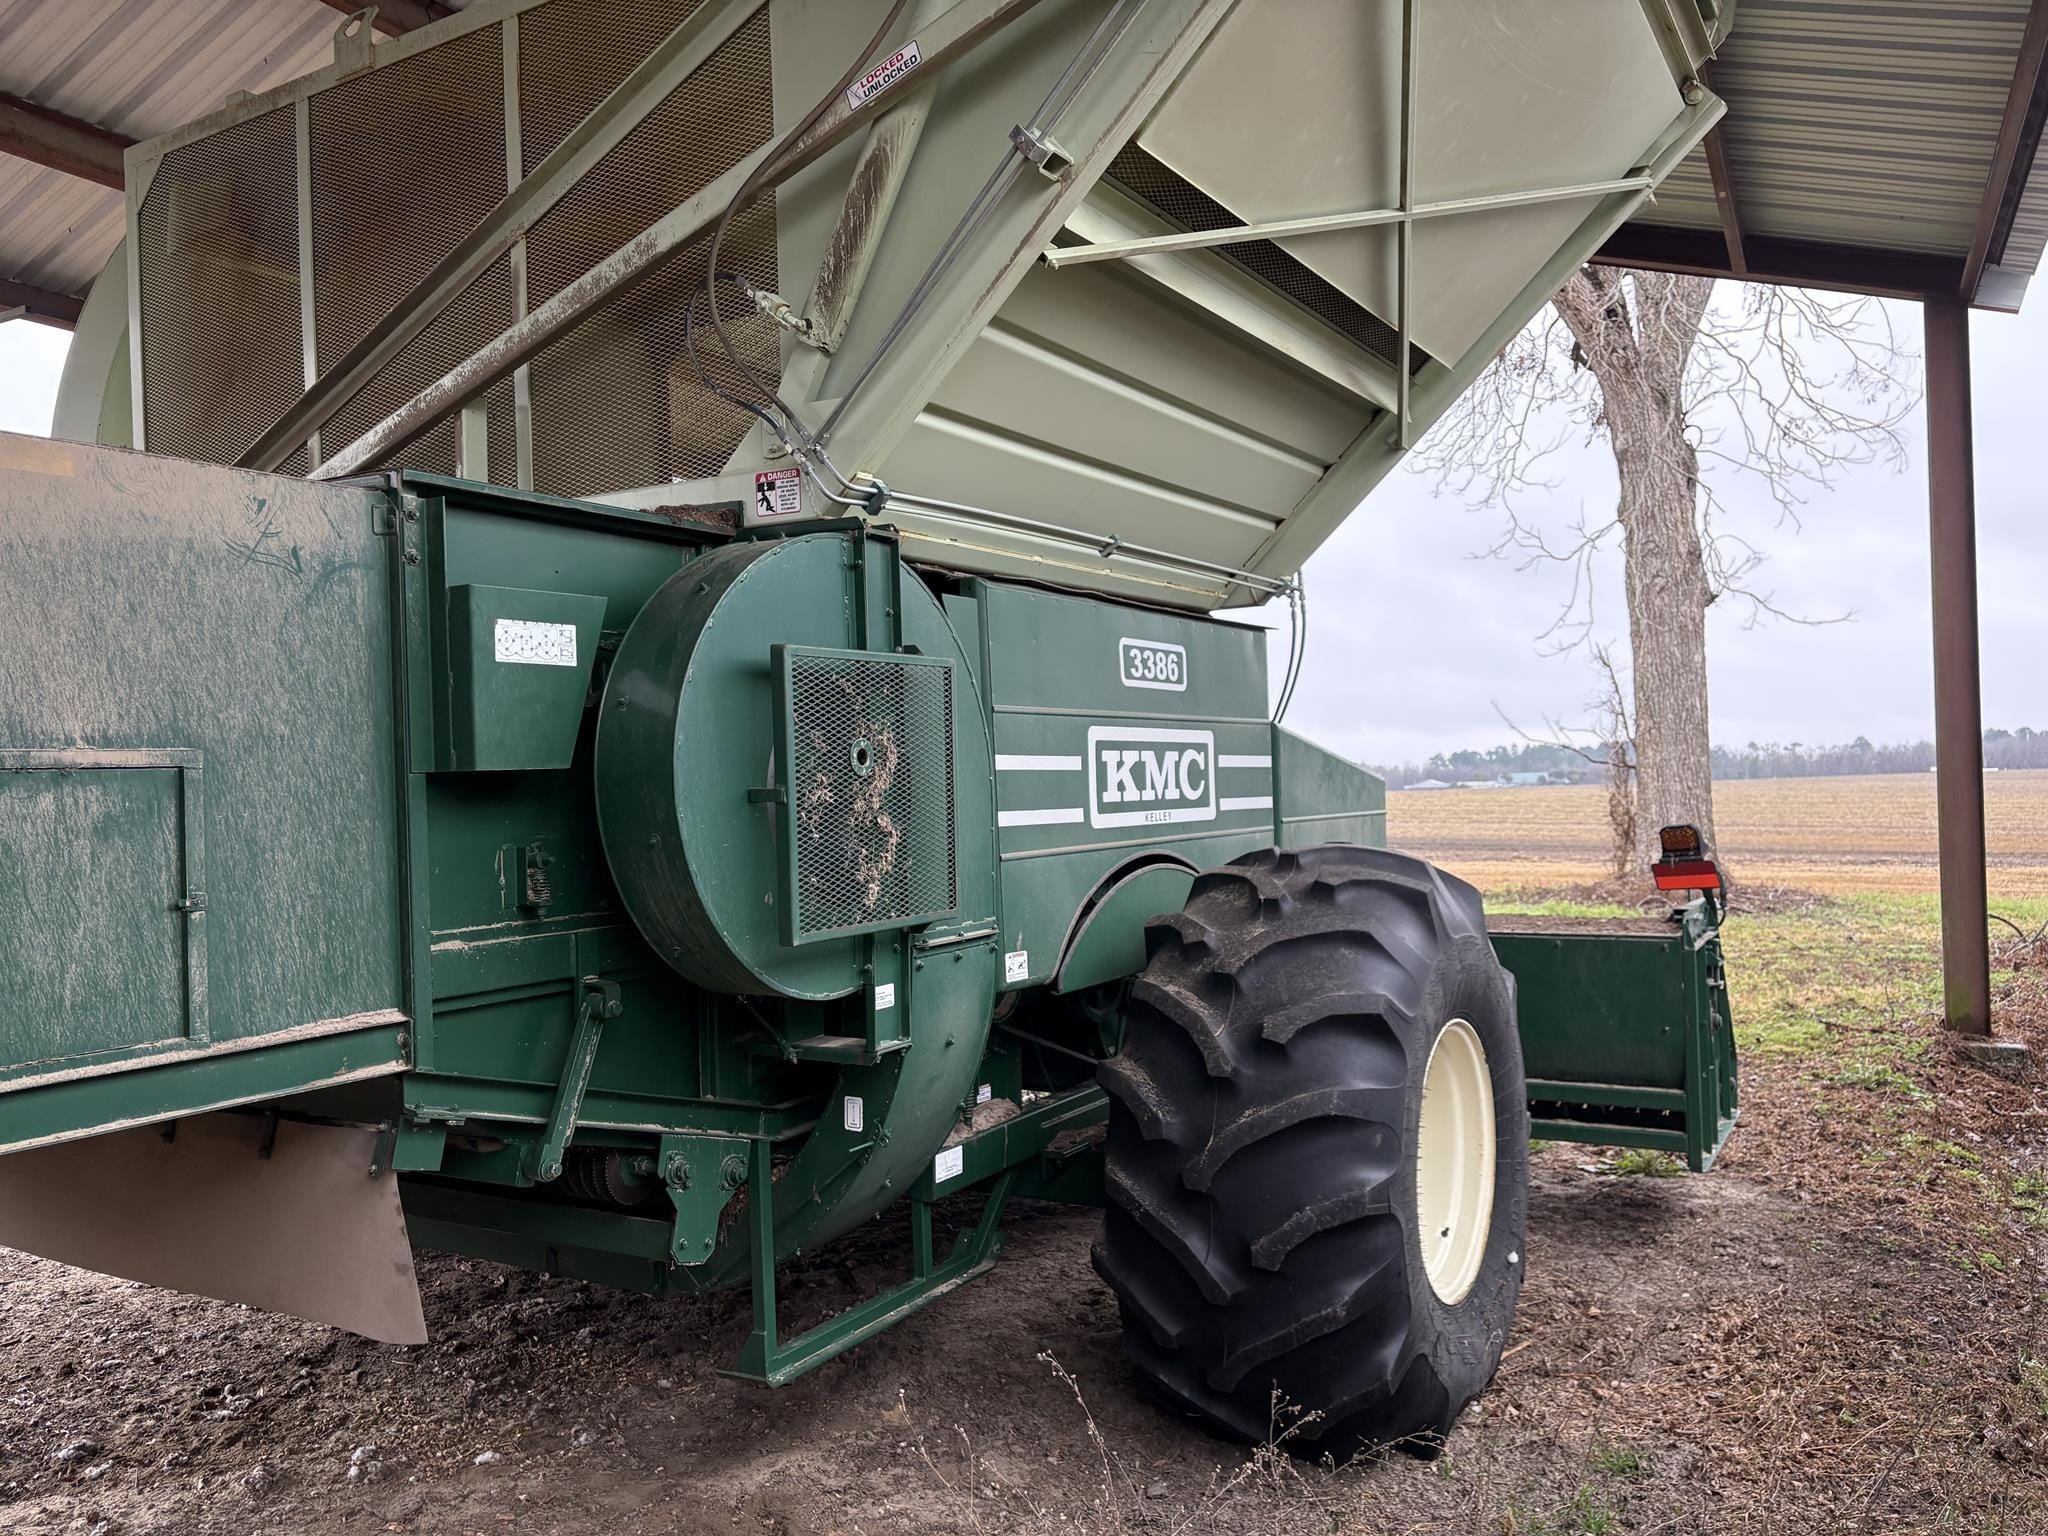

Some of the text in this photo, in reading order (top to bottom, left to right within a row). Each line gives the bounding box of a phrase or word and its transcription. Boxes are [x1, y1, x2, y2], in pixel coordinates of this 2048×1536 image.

[860, 52, 904, 89] LOCKED
[863, 54, 918, 98] UNLOCKED
[767, 469, 797, 481] DANGER
[1129, 648, 1179, 682] 3386
[1101, 748, 1205, 803] KMC
[1144, 811, 1172, 823] KELLEY
